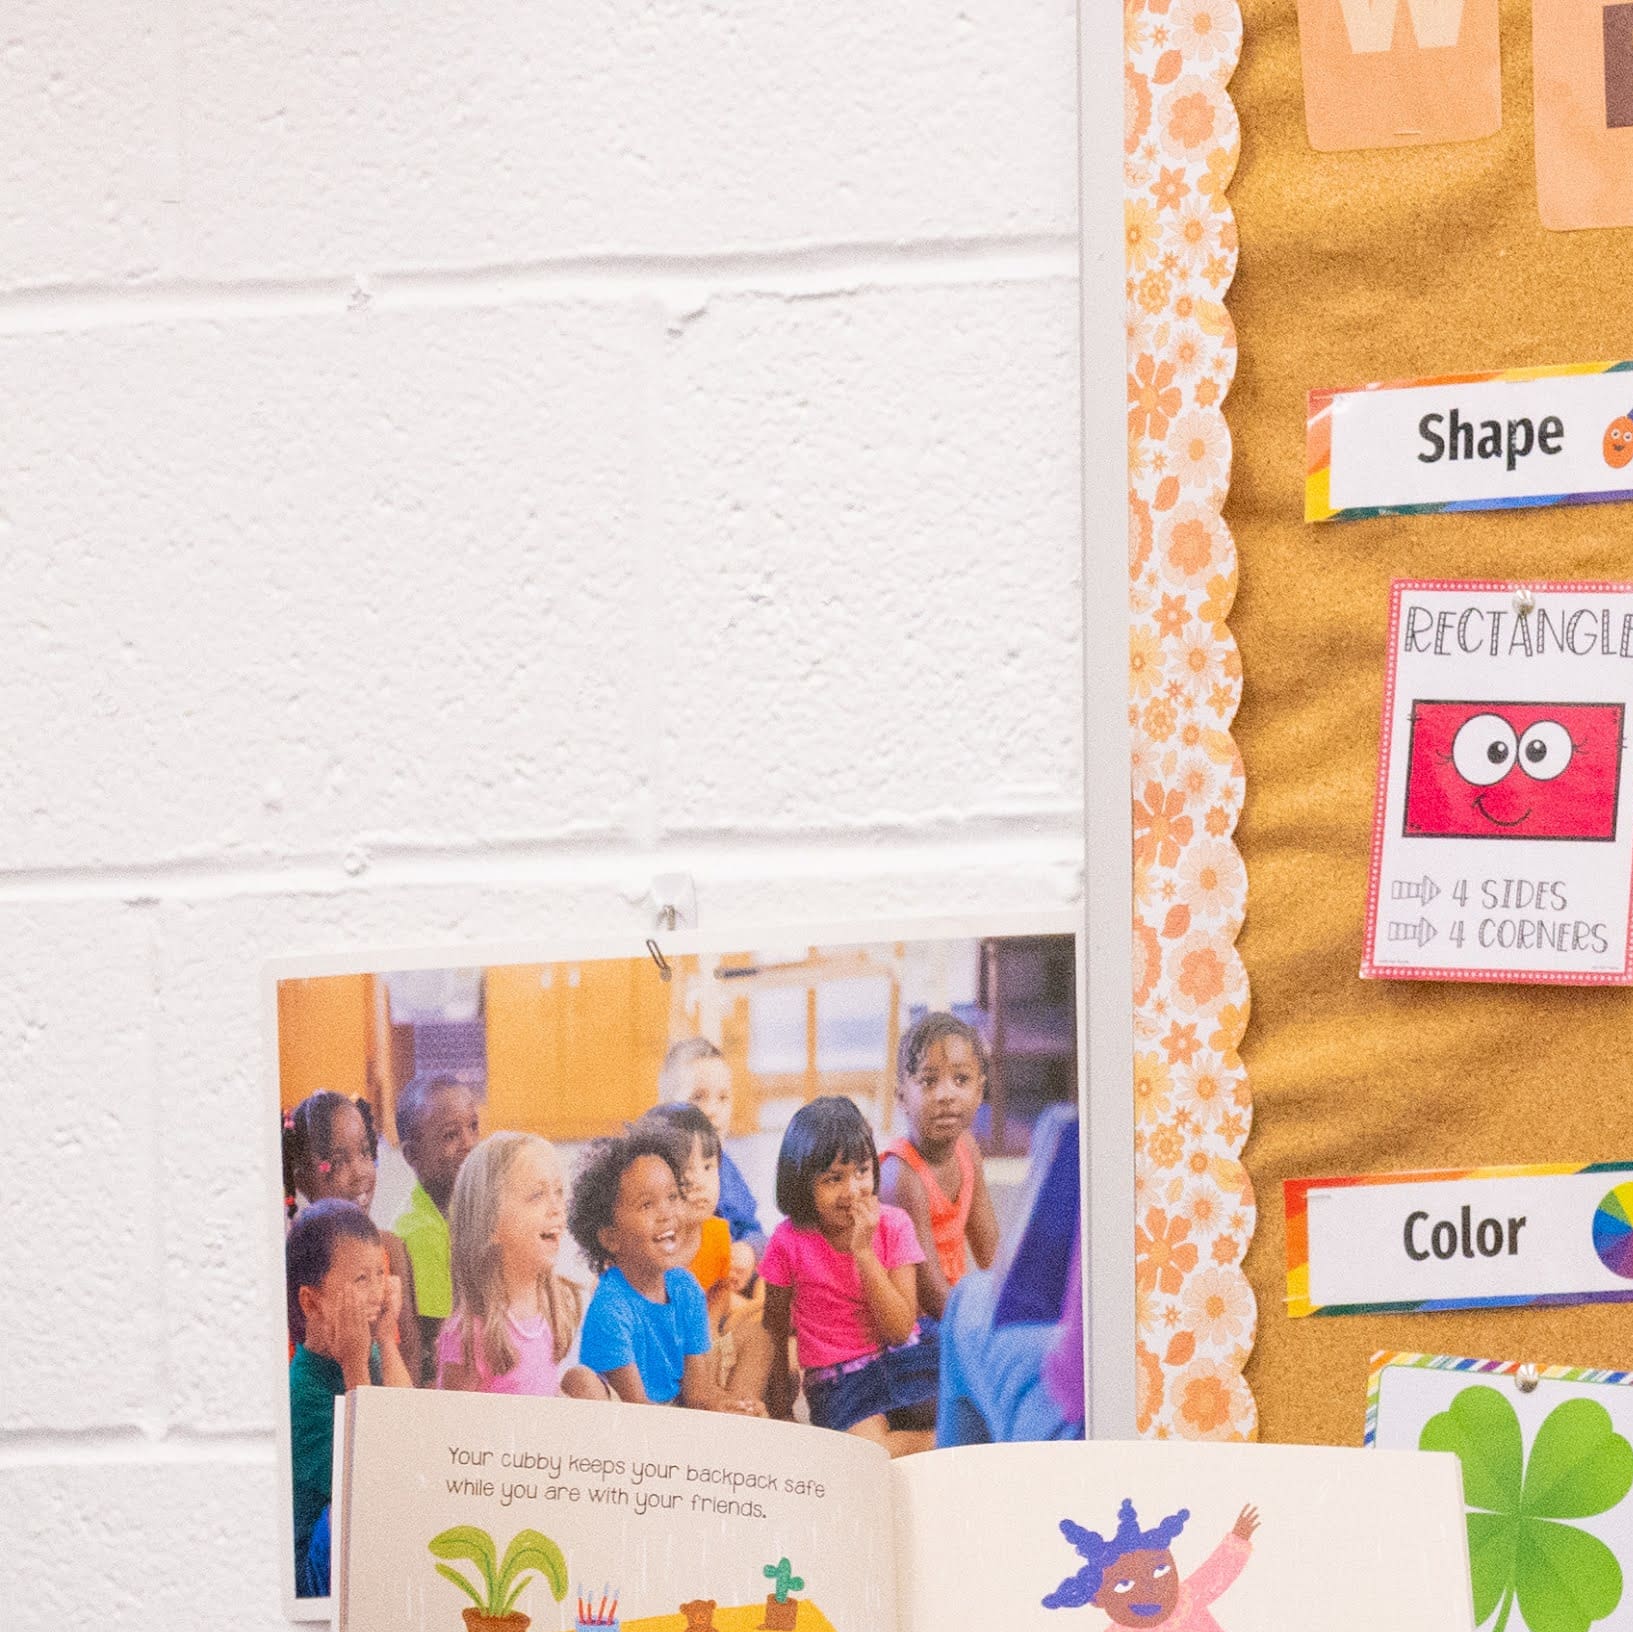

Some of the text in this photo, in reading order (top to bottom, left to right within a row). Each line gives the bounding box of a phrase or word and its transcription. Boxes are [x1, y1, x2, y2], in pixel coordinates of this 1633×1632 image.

[1417, 406, 1564, 471] Shape
[1453, 879, 1568, 911] 4 SIDES
[1449, 919, 1608, 953] 4 CORNERS
[1403, 1205, 1527, 1262] Color
[447, 1447, 826, 1498] Your cubby keeps your backpack safe
[446, 1477, 767, 1519] while you are with your friends.
